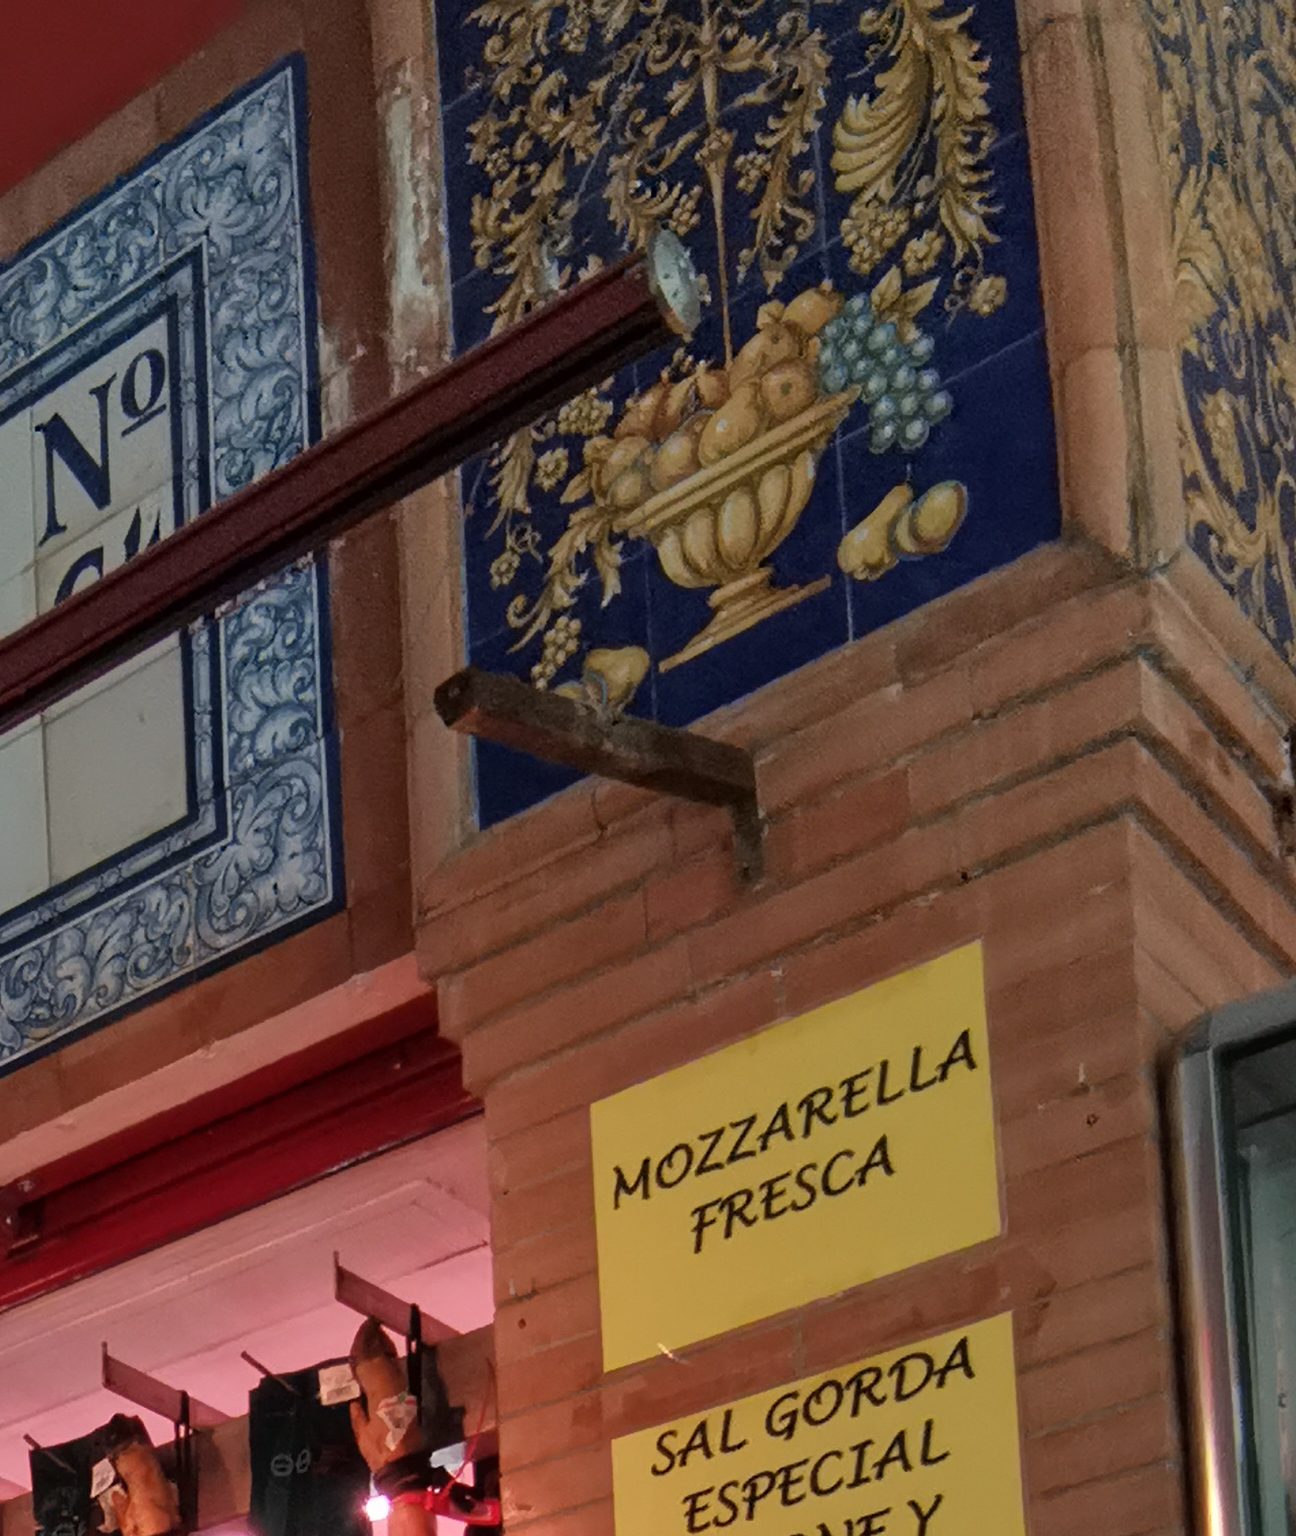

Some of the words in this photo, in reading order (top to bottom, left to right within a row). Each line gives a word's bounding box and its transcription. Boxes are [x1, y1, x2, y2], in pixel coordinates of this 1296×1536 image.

[611, 1028, 977, 1210] MOZZARELLA
[690, 1135, 895, 1254] FRESCA
[651, 1408, 746, 1478] SAL
[765, 1336, 976, 1441] GORDA
[683, 1418, 950, 1535] ESPECIAL
